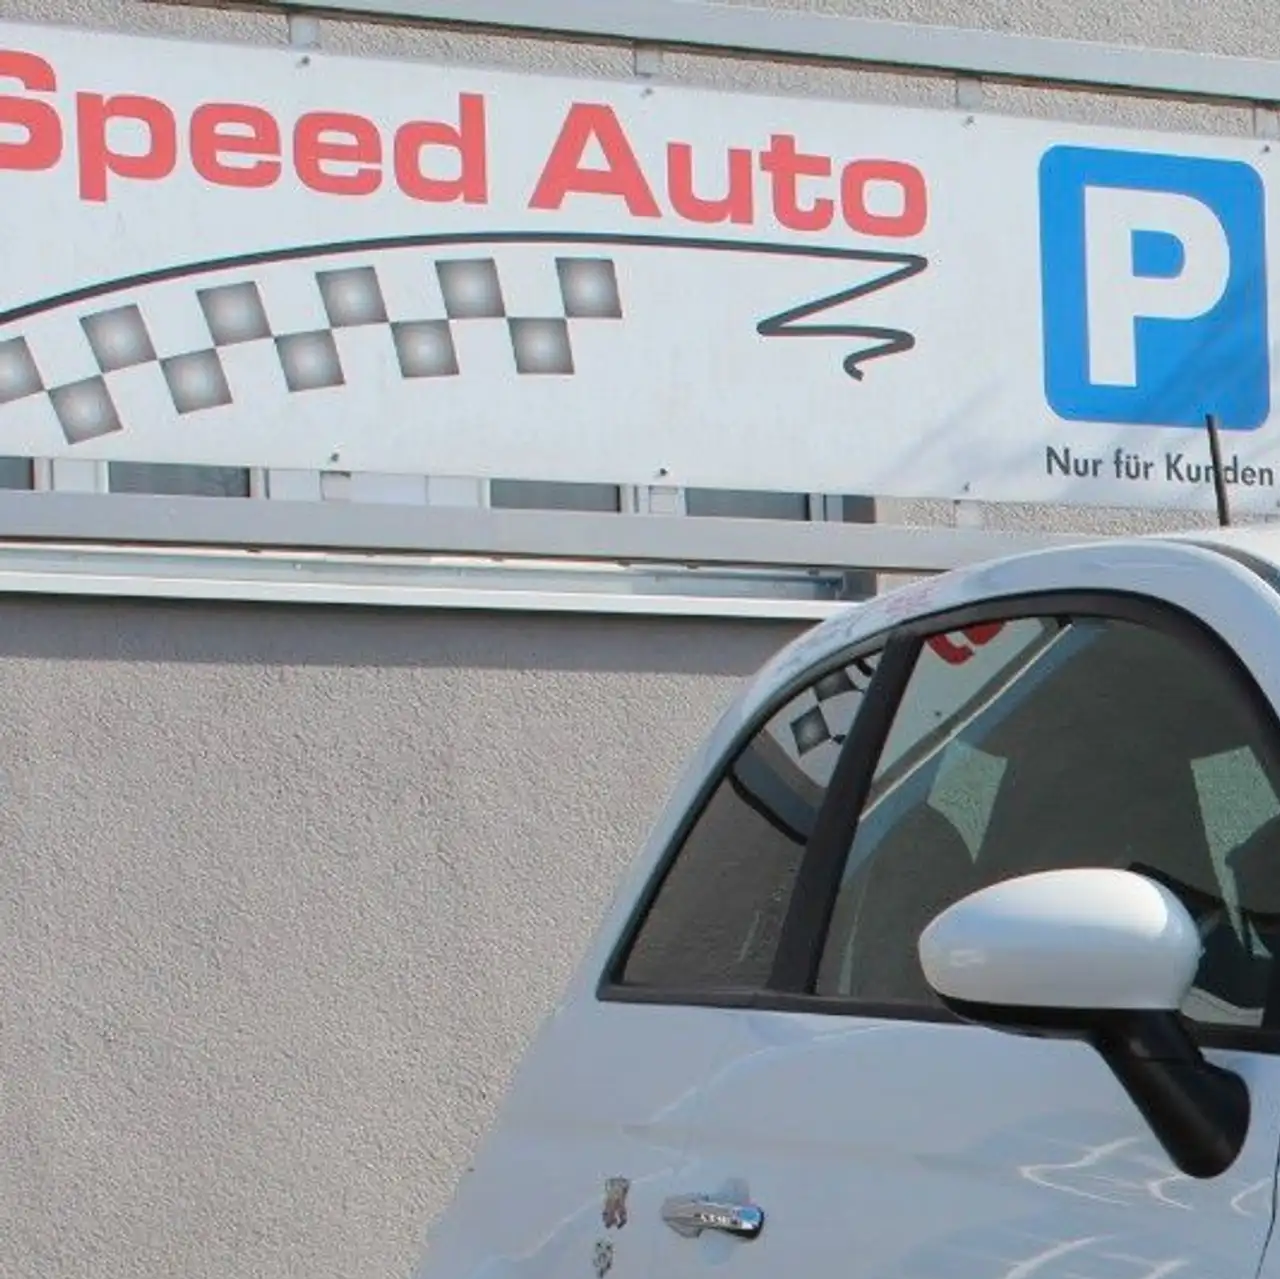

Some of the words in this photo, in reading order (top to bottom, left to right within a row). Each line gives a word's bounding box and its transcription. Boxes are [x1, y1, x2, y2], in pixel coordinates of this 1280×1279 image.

[527, 102, 928, 238] Auto
[1084, 185, 1231, 387] P
[1046, 445, 1102, 478] Nur
[1113, 448, 1154, 481] für
[1165, 452, 1274, 486] Kunden
